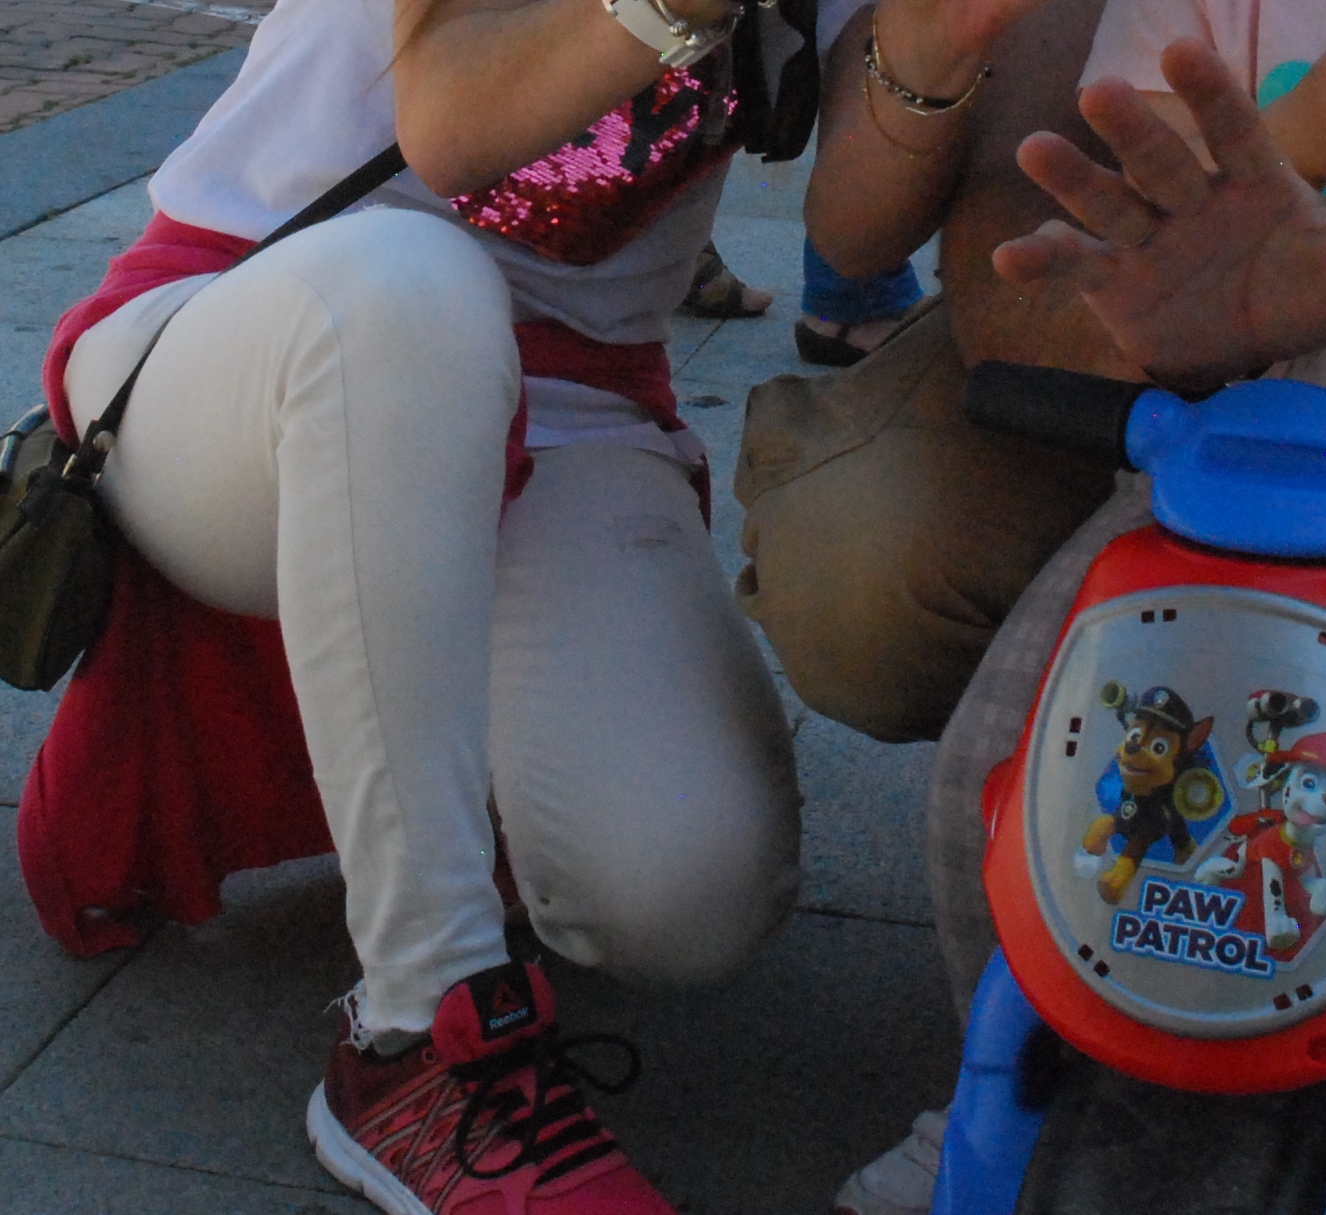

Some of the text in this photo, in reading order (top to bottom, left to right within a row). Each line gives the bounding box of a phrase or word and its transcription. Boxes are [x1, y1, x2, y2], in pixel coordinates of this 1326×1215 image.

[1142, 881, 1240, 927] PAW
[1113, 913, 1271, 973] PATROL
[489, 1006, 529, 1030] Reebok
